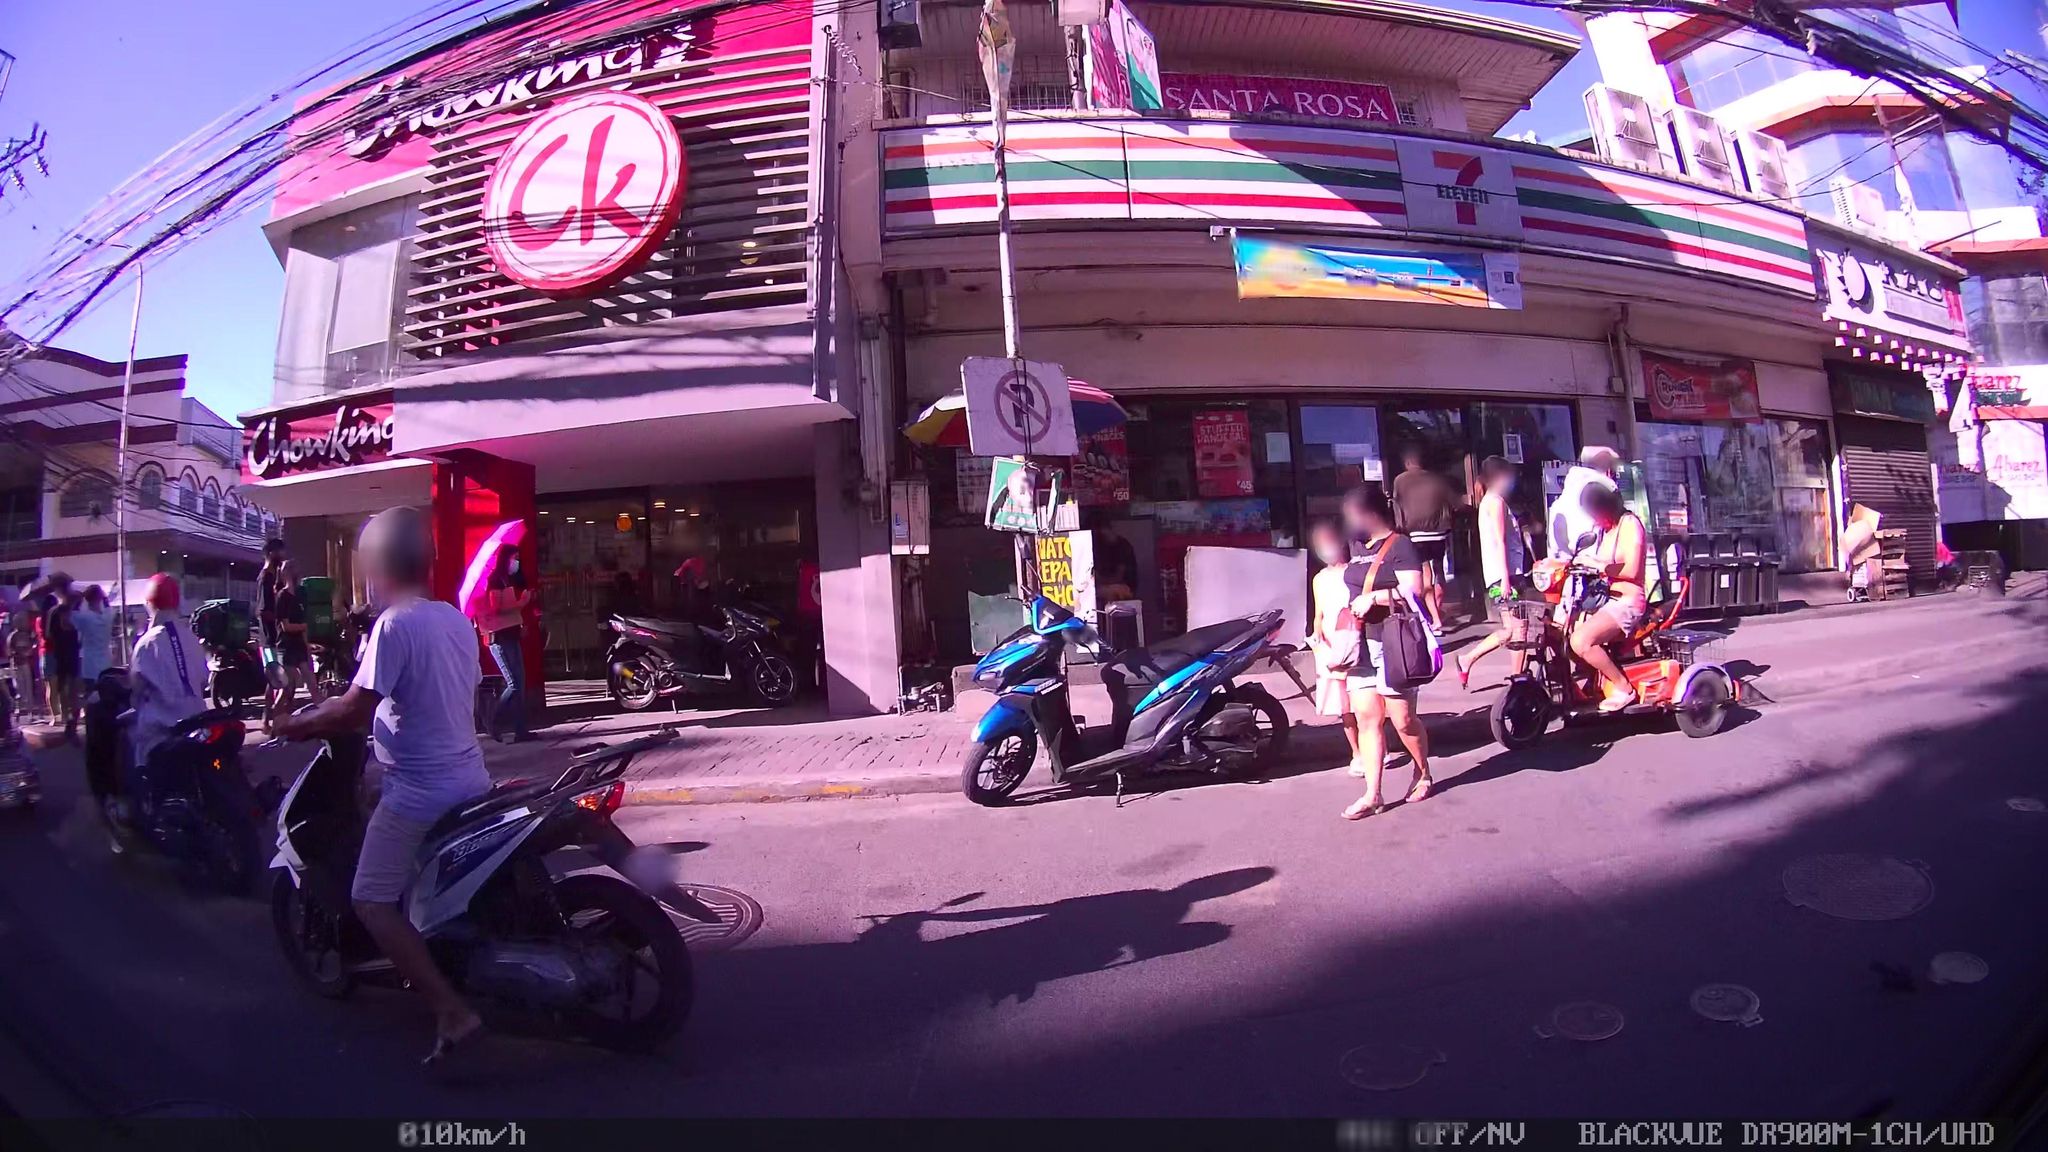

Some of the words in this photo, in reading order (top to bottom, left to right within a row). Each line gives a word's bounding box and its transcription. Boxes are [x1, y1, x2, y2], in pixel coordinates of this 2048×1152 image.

[1165, 86, 1280, 112] SANTA
[1293, 91, 1389, 121] ROSA
[1433, 151, 1484, 225] 7
